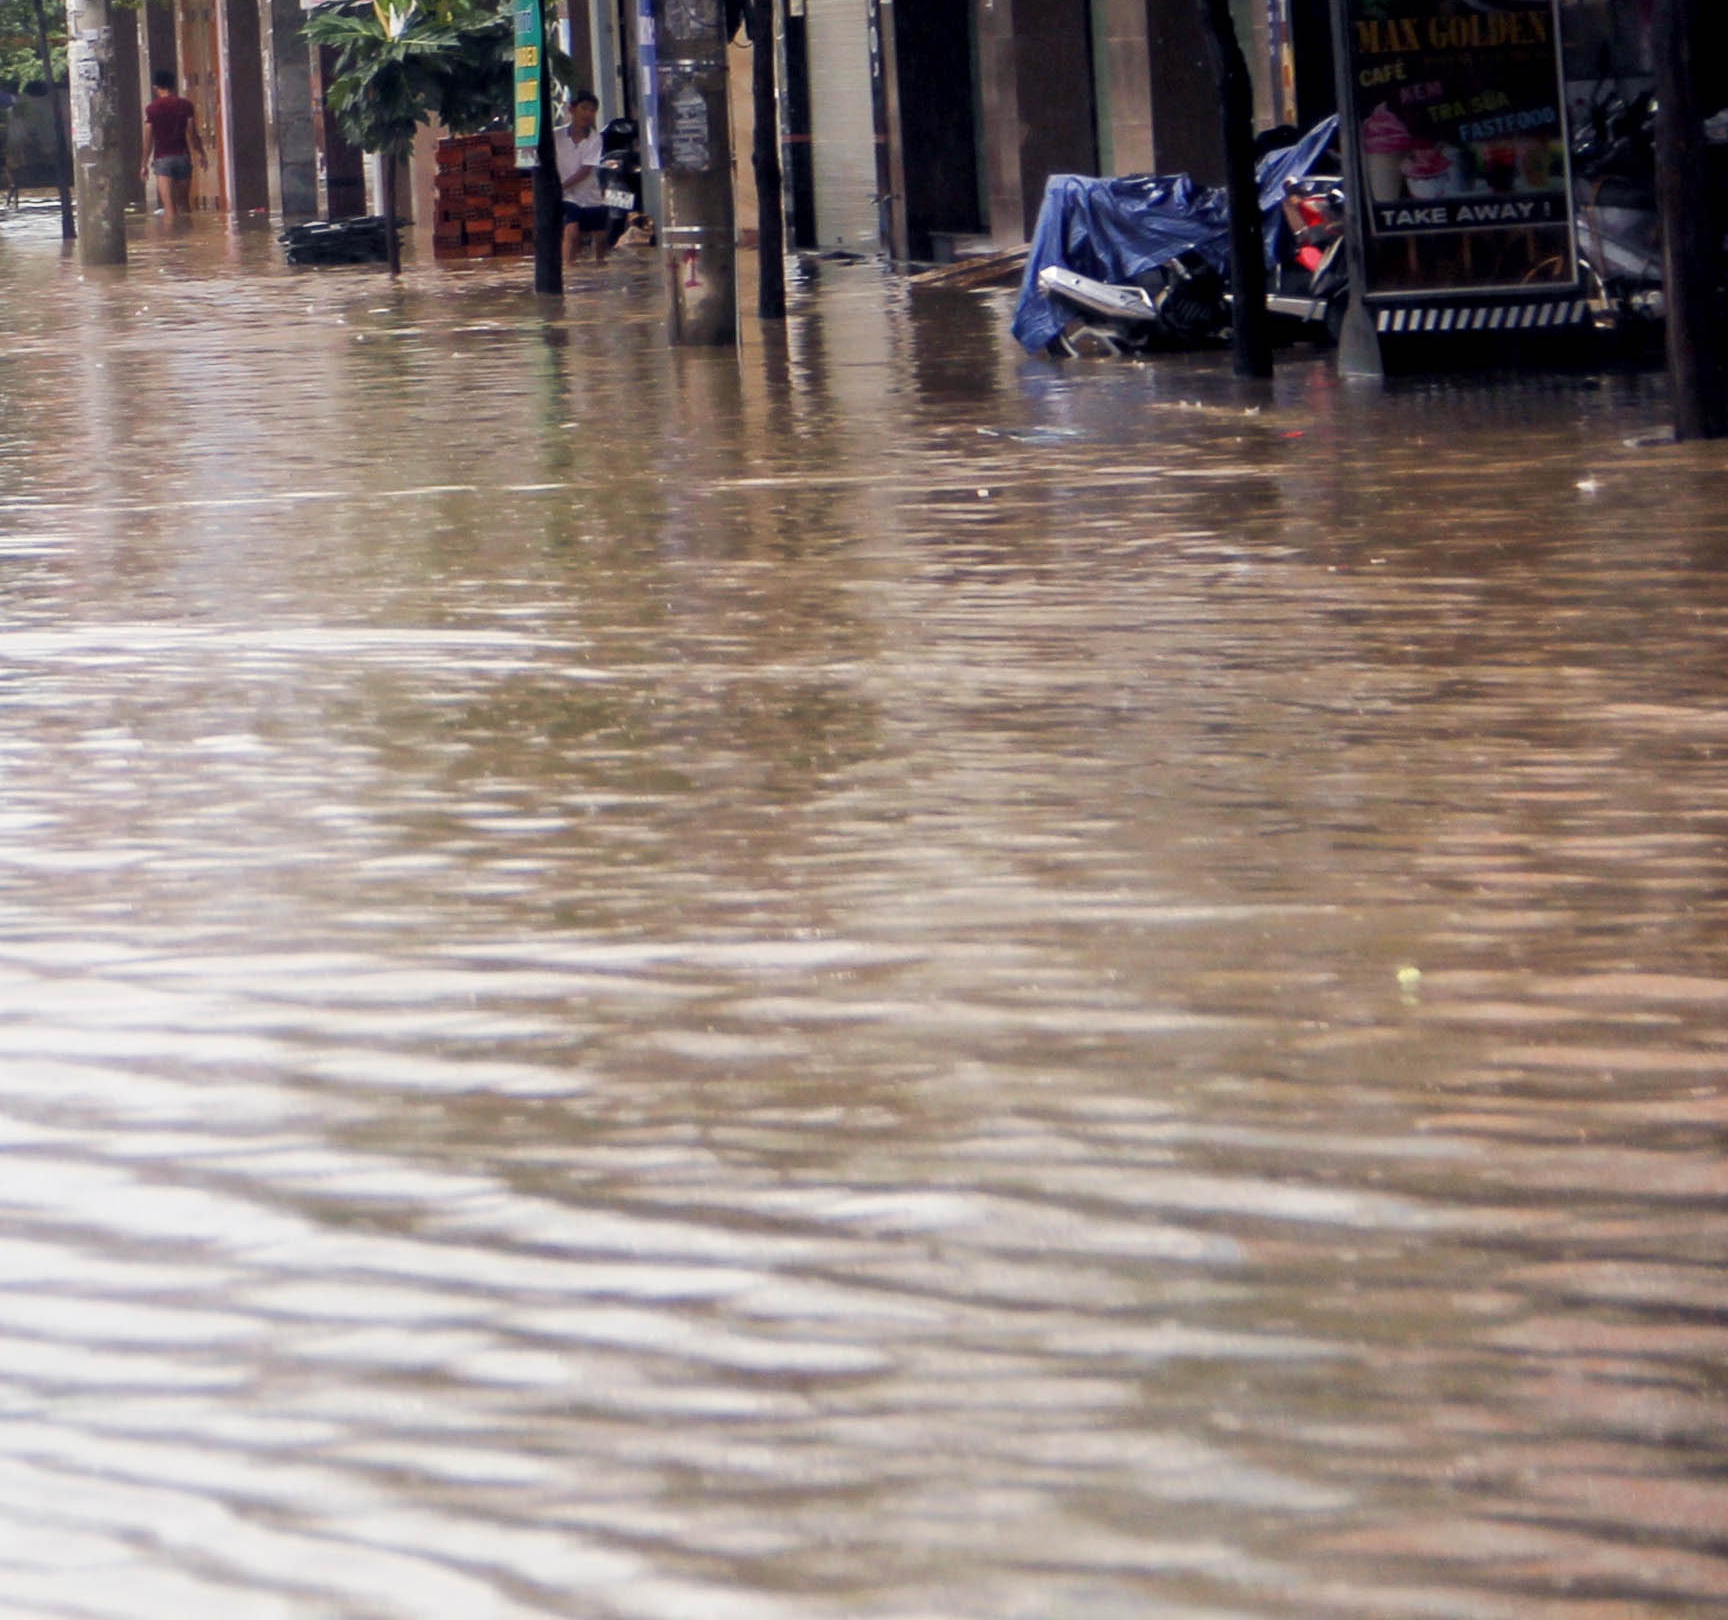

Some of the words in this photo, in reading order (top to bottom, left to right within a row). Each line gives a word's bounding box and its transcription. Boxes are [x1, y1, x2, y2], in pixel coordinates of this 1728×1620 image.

[1356, 17, 1421, 53] MAX
[1428, 10, 1547, 49] GOLDEN
[1399, 81, 1443, 103] KEM
[1458, 106, 1557, 141] FASTFOOD
[1381, 206, 1448, 227] TAKE
[1455, 201, 1535, 223] AWAY
